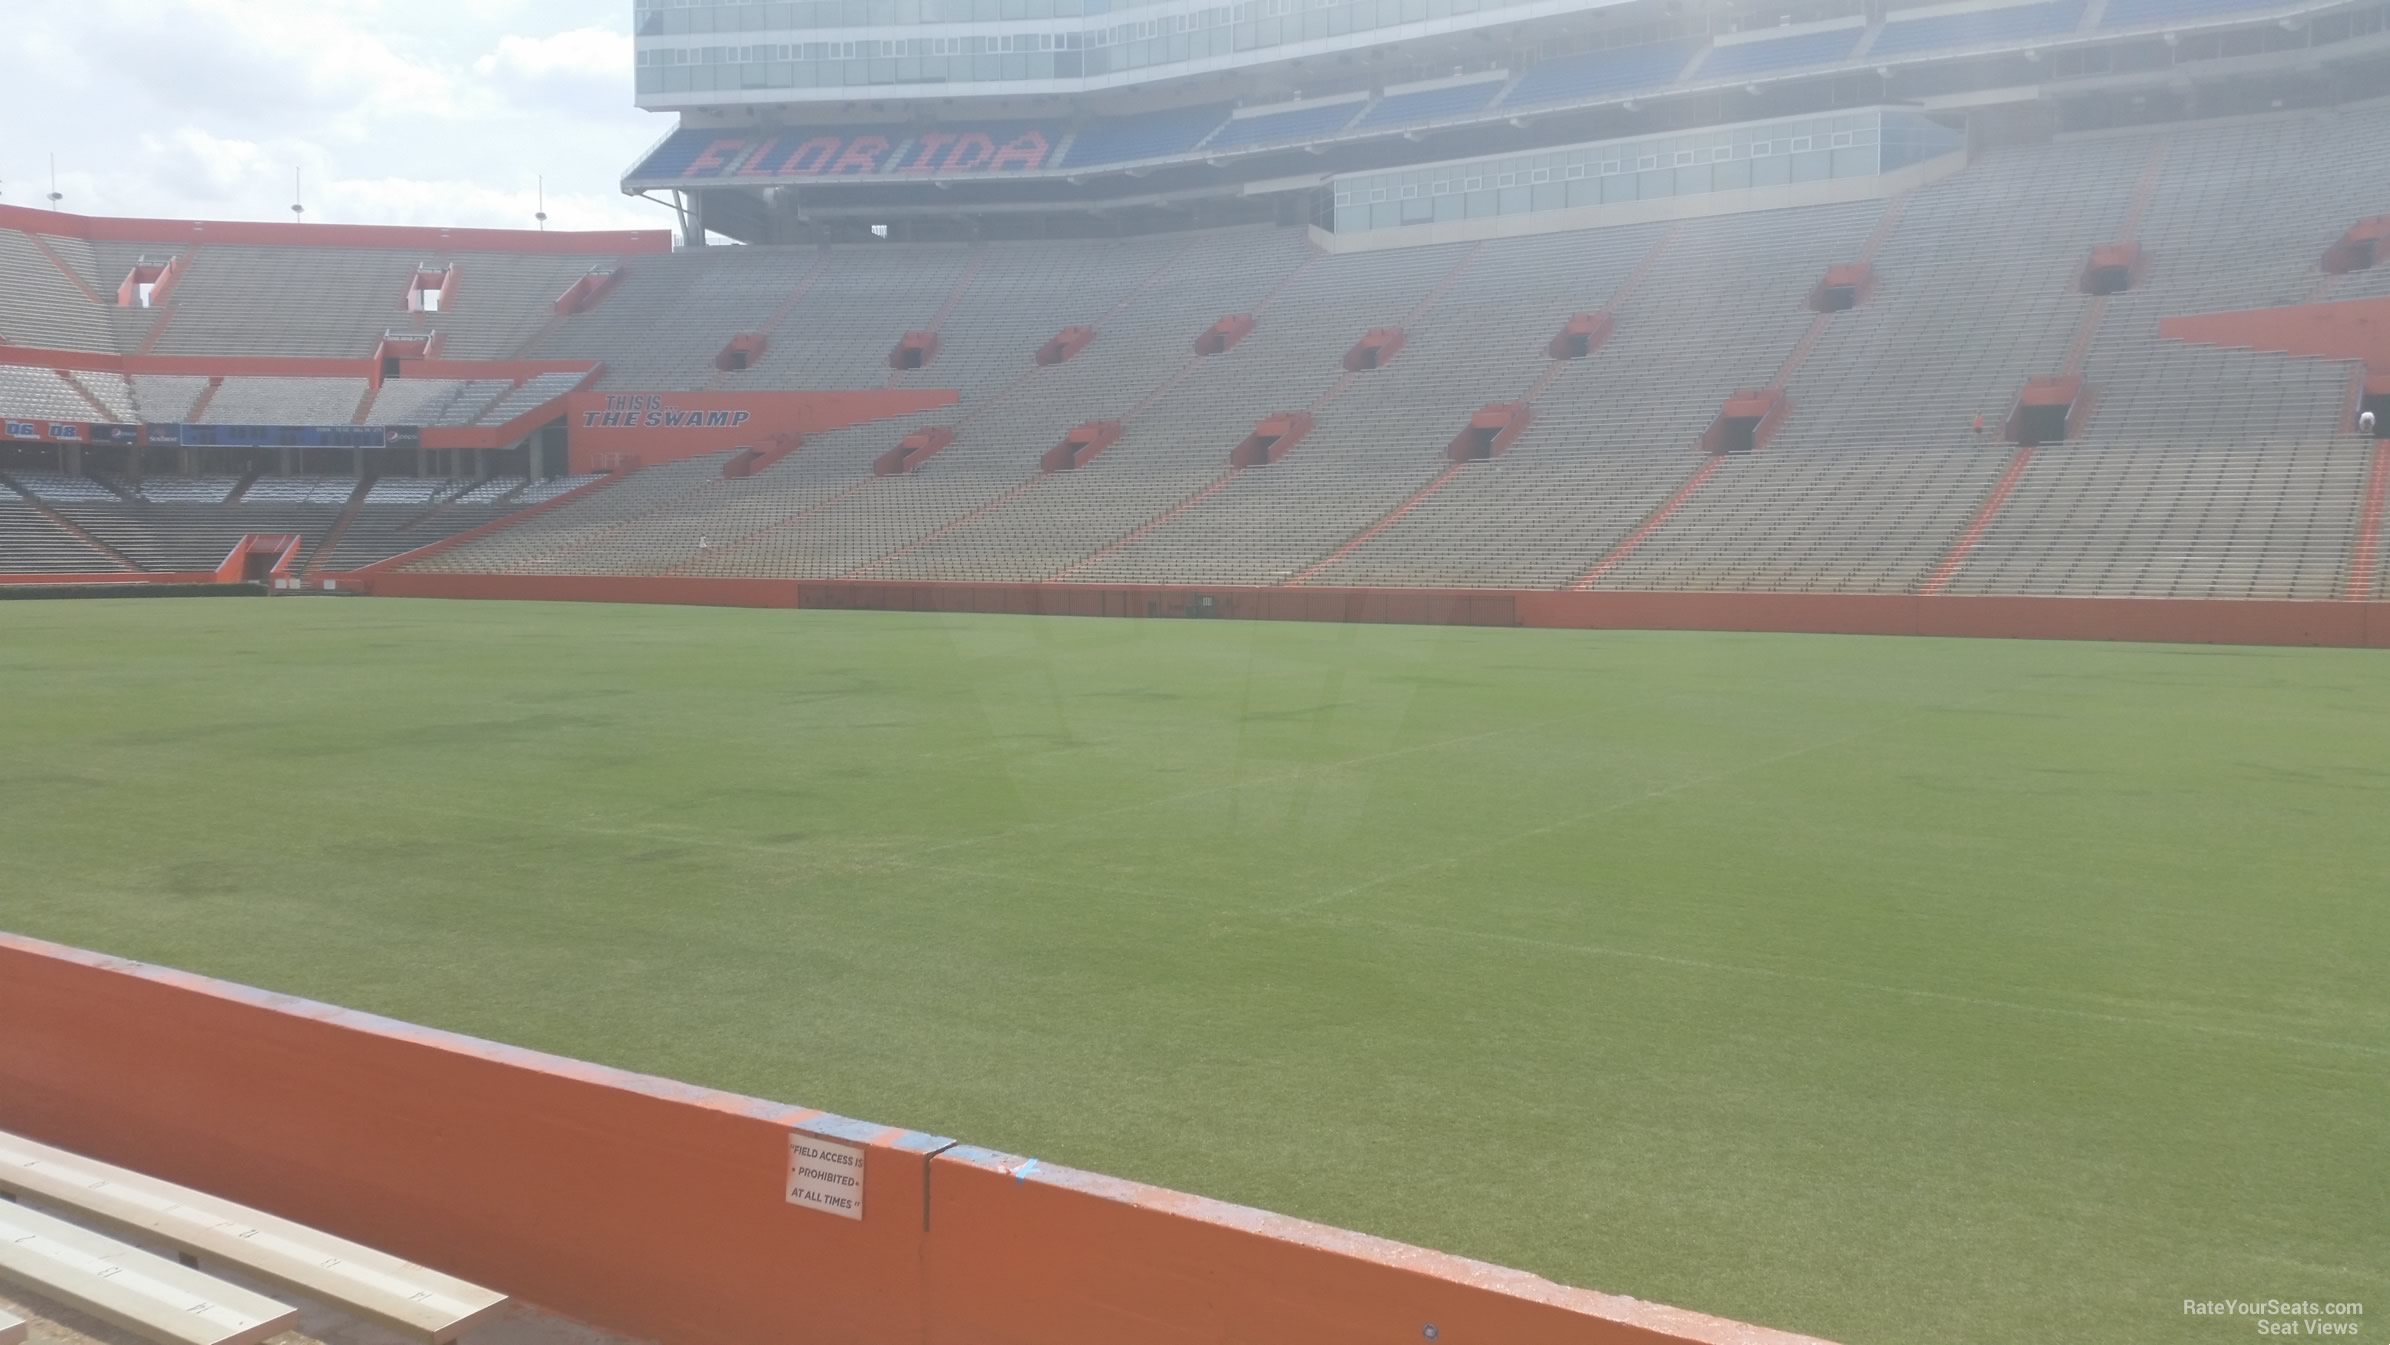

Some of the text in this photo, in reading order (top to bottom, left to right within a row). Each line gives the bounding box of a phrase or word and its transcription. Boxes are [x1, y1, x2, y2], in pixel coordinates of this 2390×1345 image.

[682, 130, 1049, 178] FLORIDA
[606, 395, 644, 411] THIS
[583, 410, 751, 428] THE SWAMP
[819, 1150, 854, 1166] ACCESS
[855, 1158, 864, 1168] IS
[791, 1187, 804, 1198] AT
[804, 1190, 821, 1202] ALL
